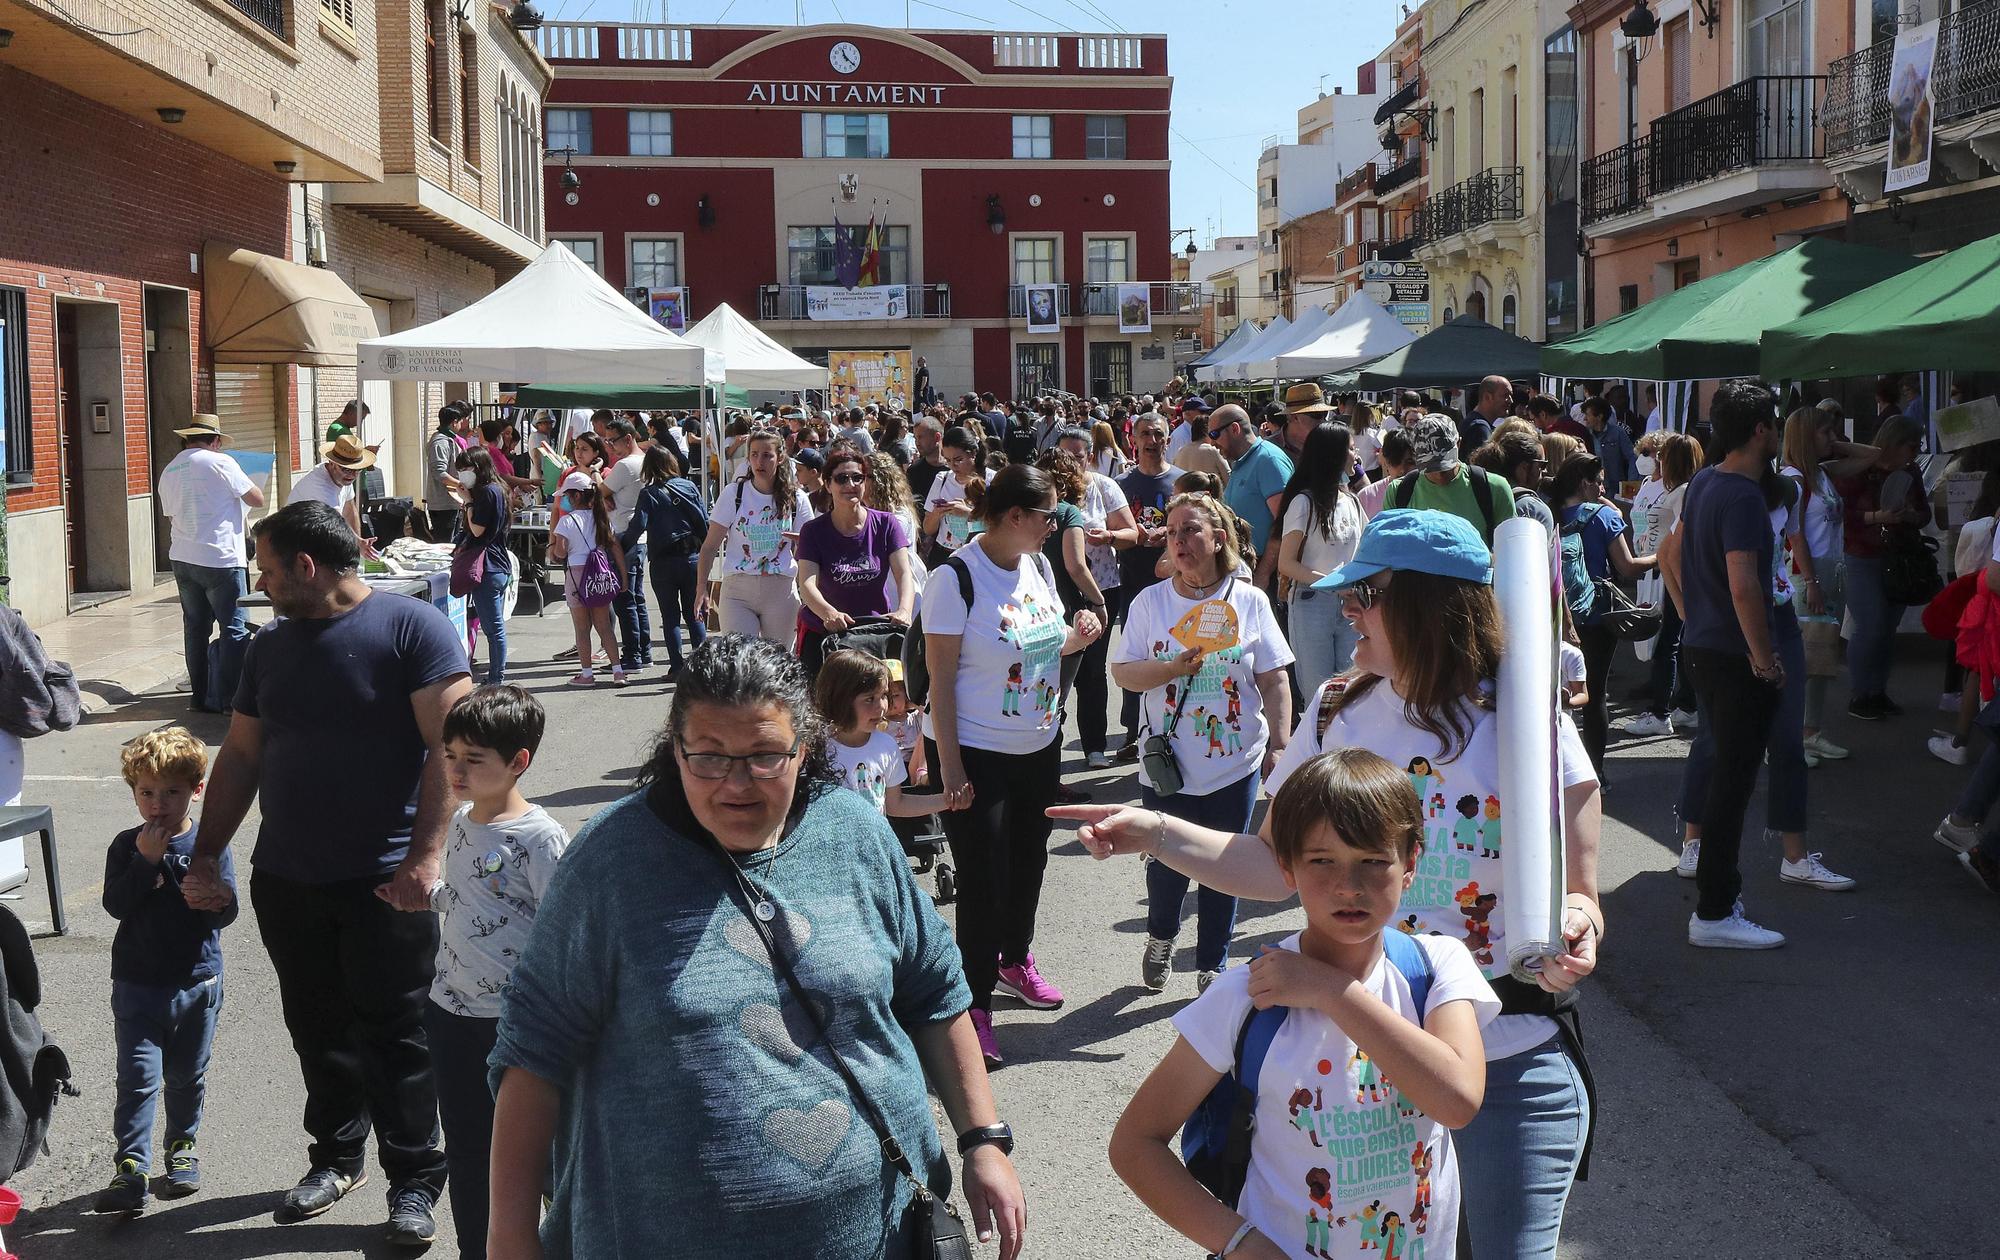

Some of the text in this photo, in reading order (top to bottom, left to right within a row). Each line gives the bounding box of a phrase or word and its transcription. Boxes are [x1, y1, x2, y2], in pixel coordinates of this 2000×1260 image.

[747, 83, 946, 104] AJUNTAMENT
[408, 349, 462, 357] UNIVERSITAT
[409, 356, 463, 364] POLITÈCNICA
[409, 364, 464, 373] DE VALÈNCIA
[857, 377, 886, 388] LLIURES
[1199, 621, 1221, 632] LLIURES
[1215, 663, 1227, 676] fa
[1445, 855, 1470, 879] fa
[1327, 1122, 1417, 1162] que ens fa
[1336, 1148, 1410, 1186] LLIURES
[1366, 1176, 1410, 1193] valenciana
